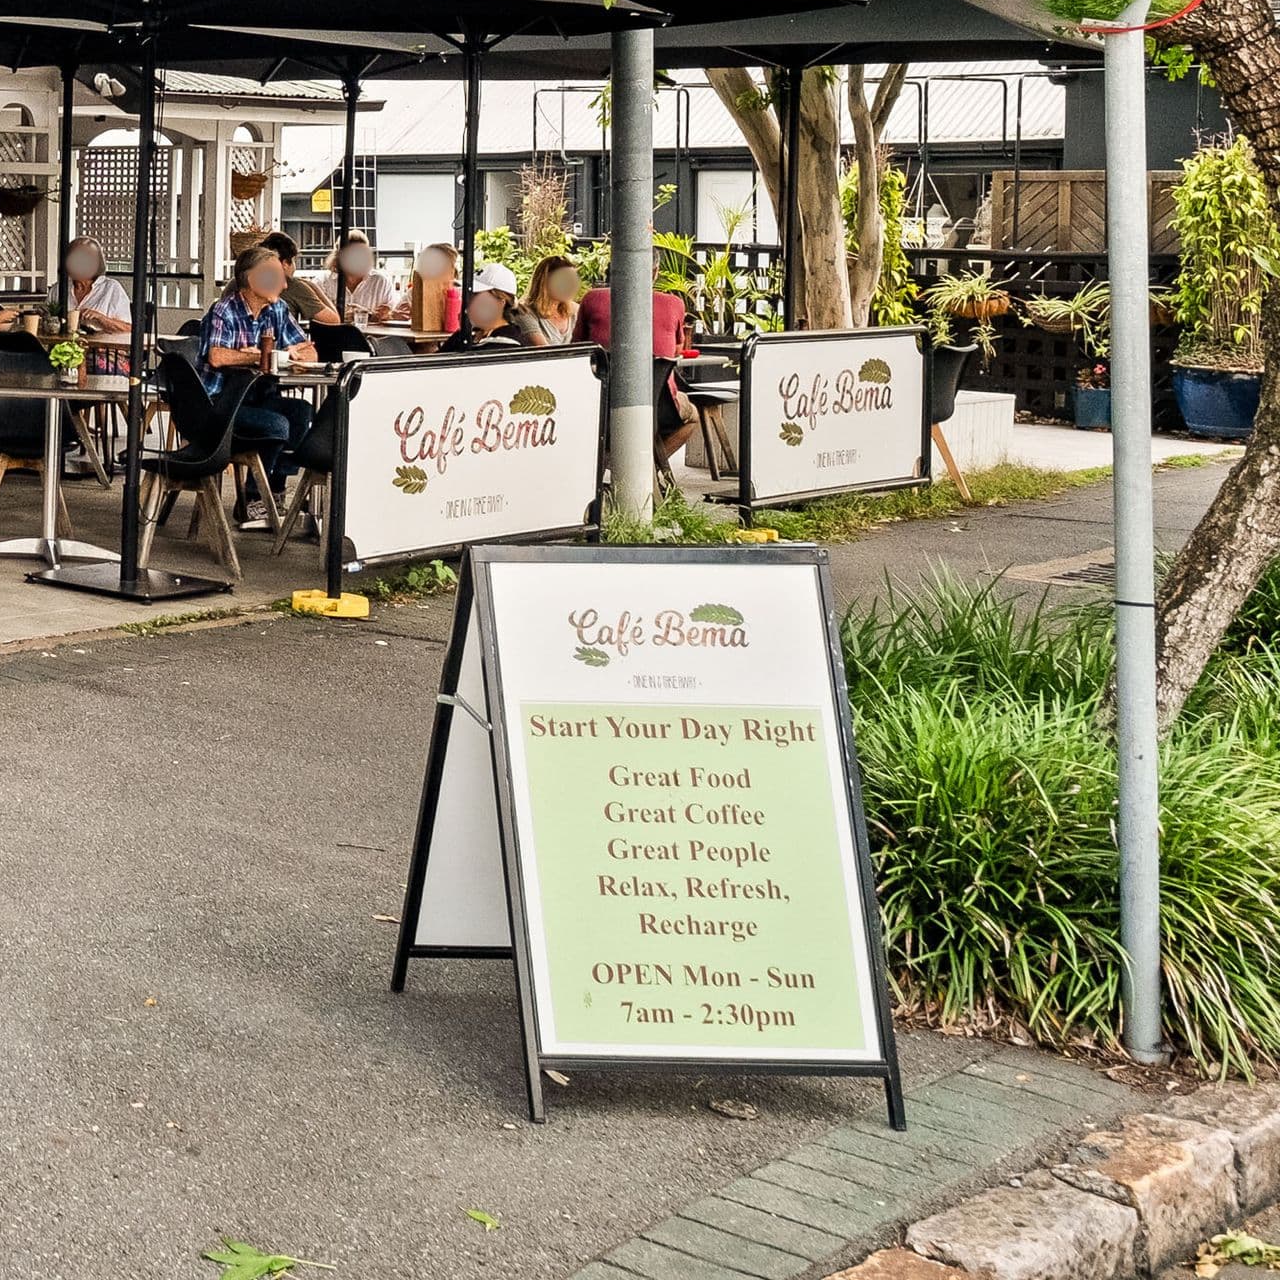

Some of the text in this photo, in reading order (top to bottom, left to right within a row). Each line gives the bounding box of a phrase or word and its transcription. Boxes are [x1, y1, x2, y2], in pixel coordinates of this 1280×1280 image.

[778, 369, 893, 431] Café Bema
[394, 399, 558, 475] Café Bema
[568, 608, 751, 657] Café Bema
[529, 714, 817, 748] Start Your Day Right
[608, 764, 752, 790] Great Food
[603, 801, 766, 826] Great Coffee
[606, 837, 771, 868] Great People
[596, 874, 791, 903] Relax, Refresh,
[638, 912, 758, 943] Recharge
[591, 961, 673, 986] OPEN
[682, 964, 741, 988] Mon
[766, 966, 816, 990] Sun
[620, 1001, 675, 1024] 7am
[700, 1003, 796, 1032] 2:30pm
